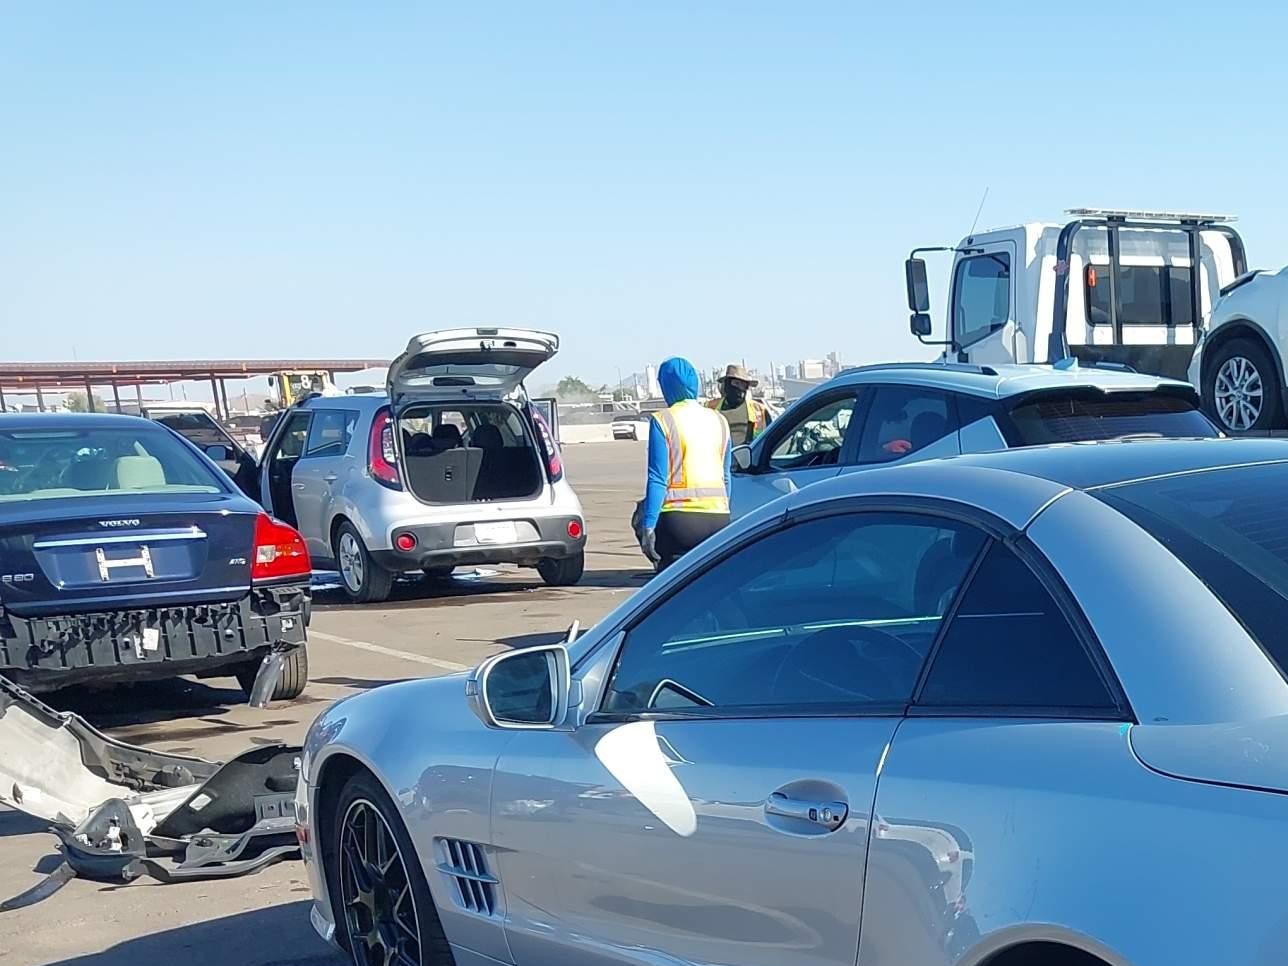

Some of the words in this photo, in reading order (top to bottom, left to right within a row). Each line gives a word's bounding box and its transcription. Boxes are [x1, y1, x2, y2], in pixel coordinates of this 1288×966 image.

[301, 375, 311, 389] 8
[98, 519, 140, 527] VOLVO
[2, 573, 34, 582] S80
